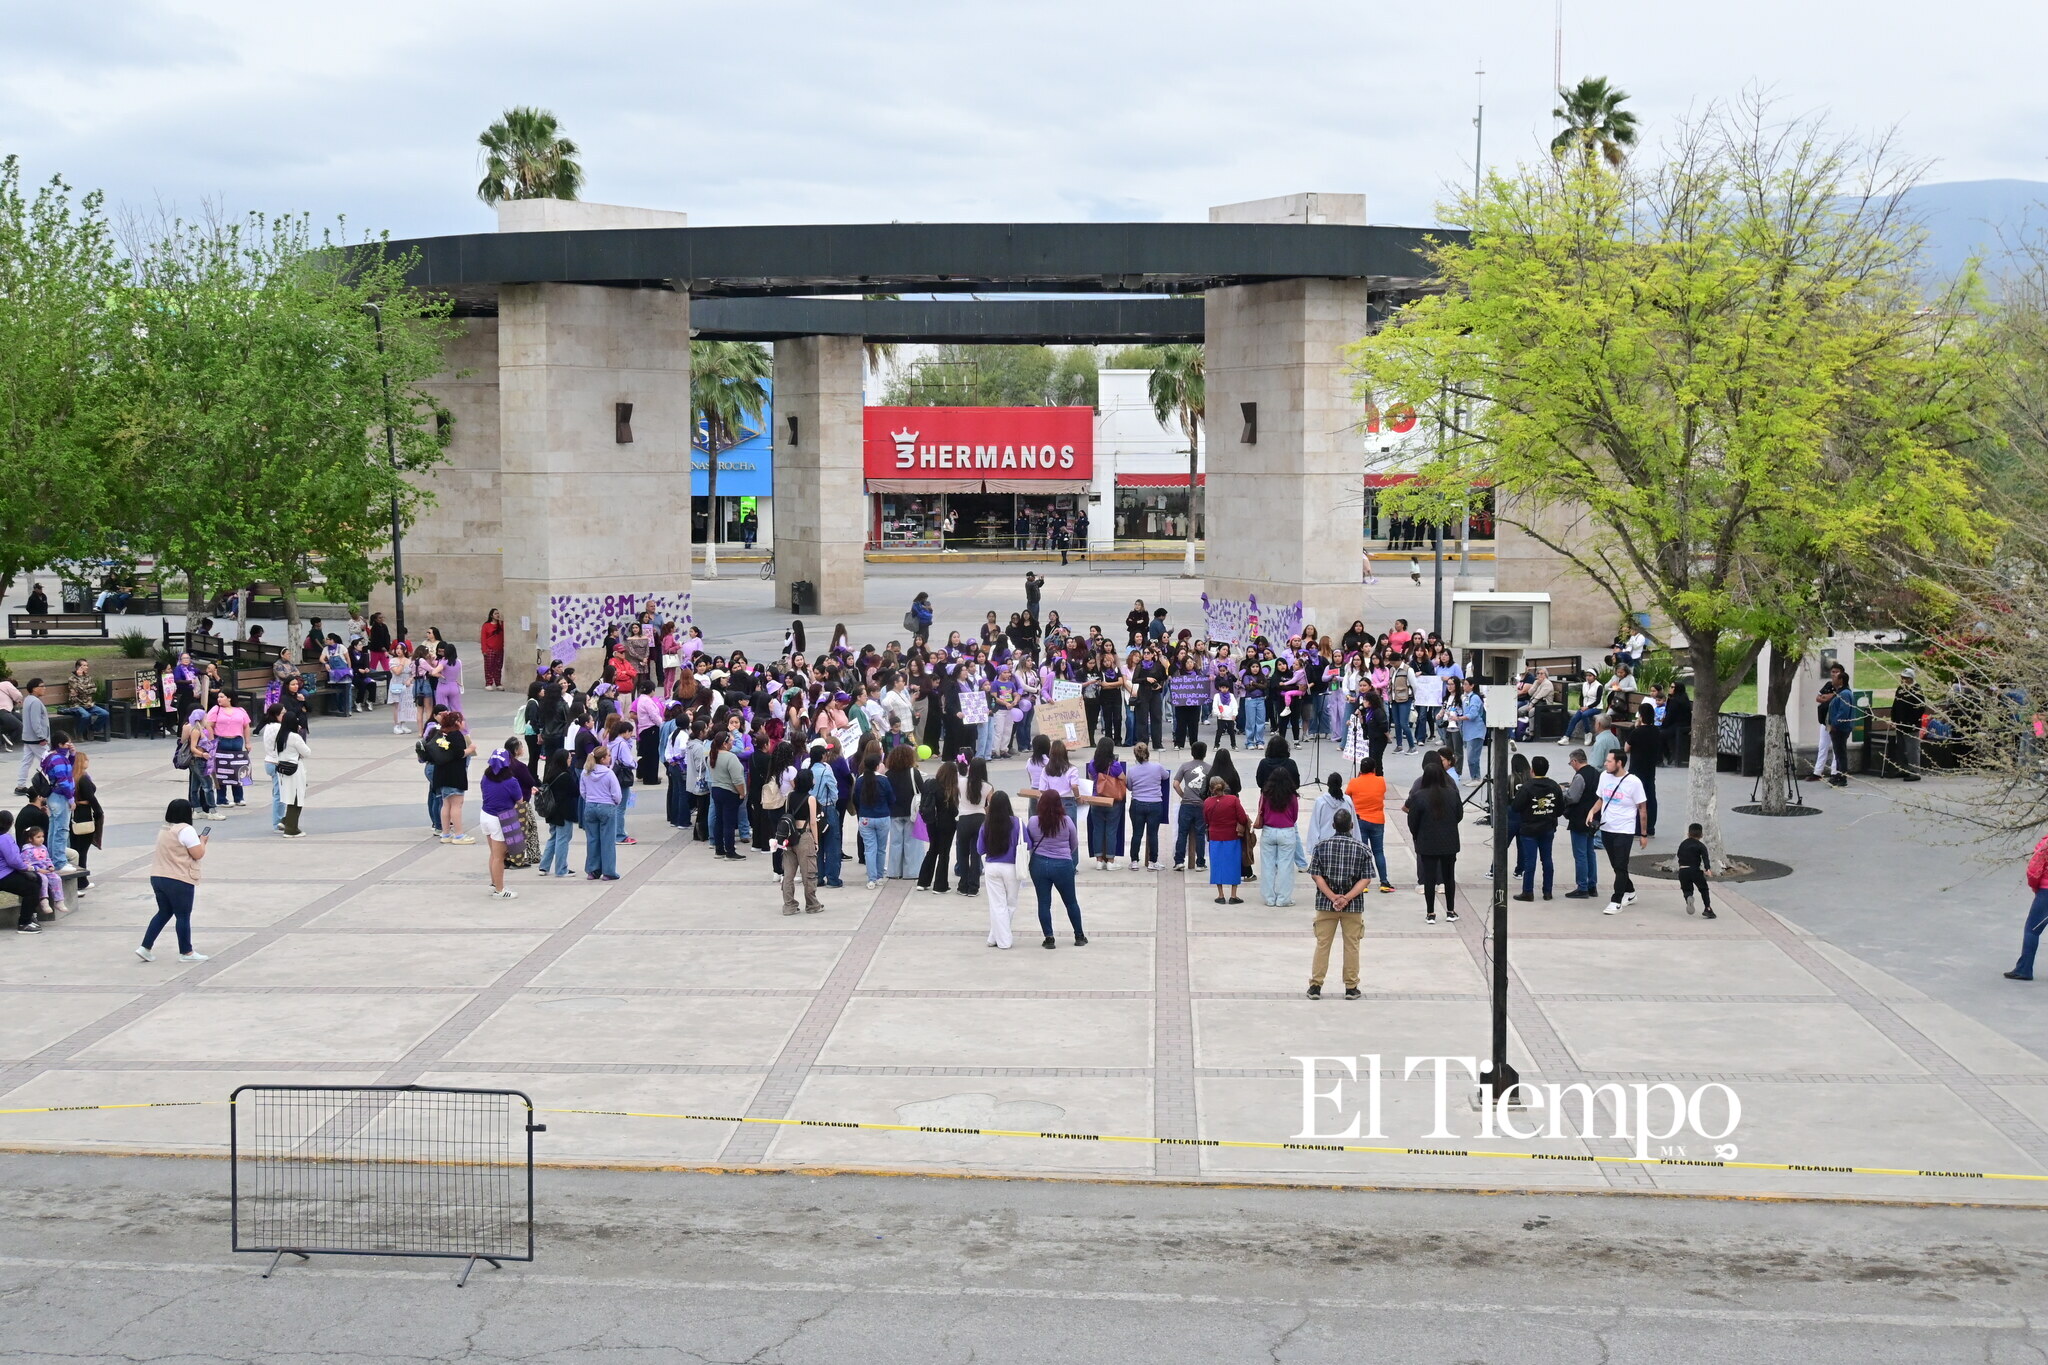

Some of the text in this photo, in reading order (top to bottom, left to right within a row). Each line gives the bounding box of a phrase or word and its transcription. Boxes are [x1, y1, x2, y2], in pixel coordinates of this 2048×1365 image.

[896, 444, 1075, 469] 3 HERMANOS
[718, 461, 757, 470] ROCHA
[605, 594, 635, 617] 8M
[1171, 691, 1209, 700] PATRIARCADO
[1054, 710, 1081, 721] PINTURA
